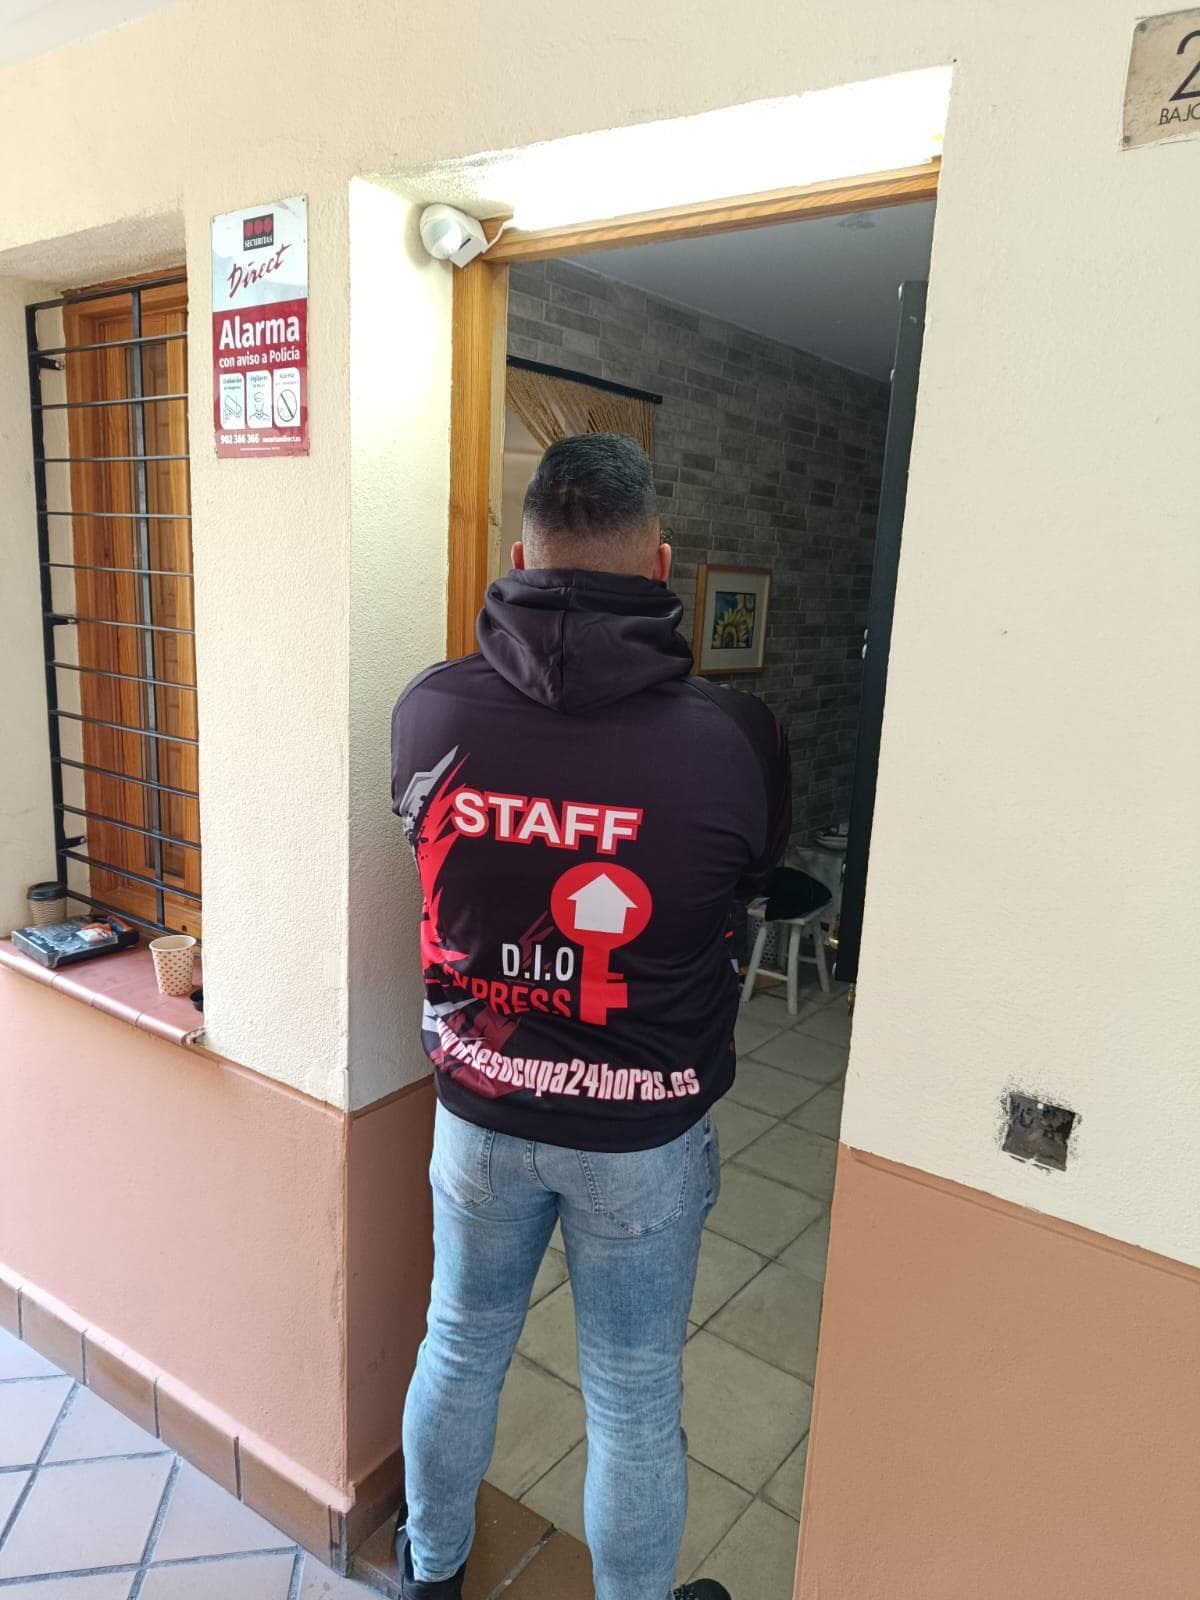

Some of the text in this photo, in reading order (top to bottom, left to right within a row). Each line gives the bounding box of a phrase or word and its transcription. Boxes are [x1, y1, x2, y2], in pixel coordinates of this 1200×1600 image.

[227, 243, 292, 298] Direct
[219, 315, 300, 350] Alarma
[219, 356, 235, 368] con
[236, 351, 260, 367] aviso
[261, 353, 268, 364] a
[220, 434, 233, 445] 902
[451, 788, 643, 854] STAFF
[501, 943, 575, 981] D.I.O
[443, 963, 572, 1018] PRESS
[435, 1016, 700, 1101] .desocupa24horas.es
